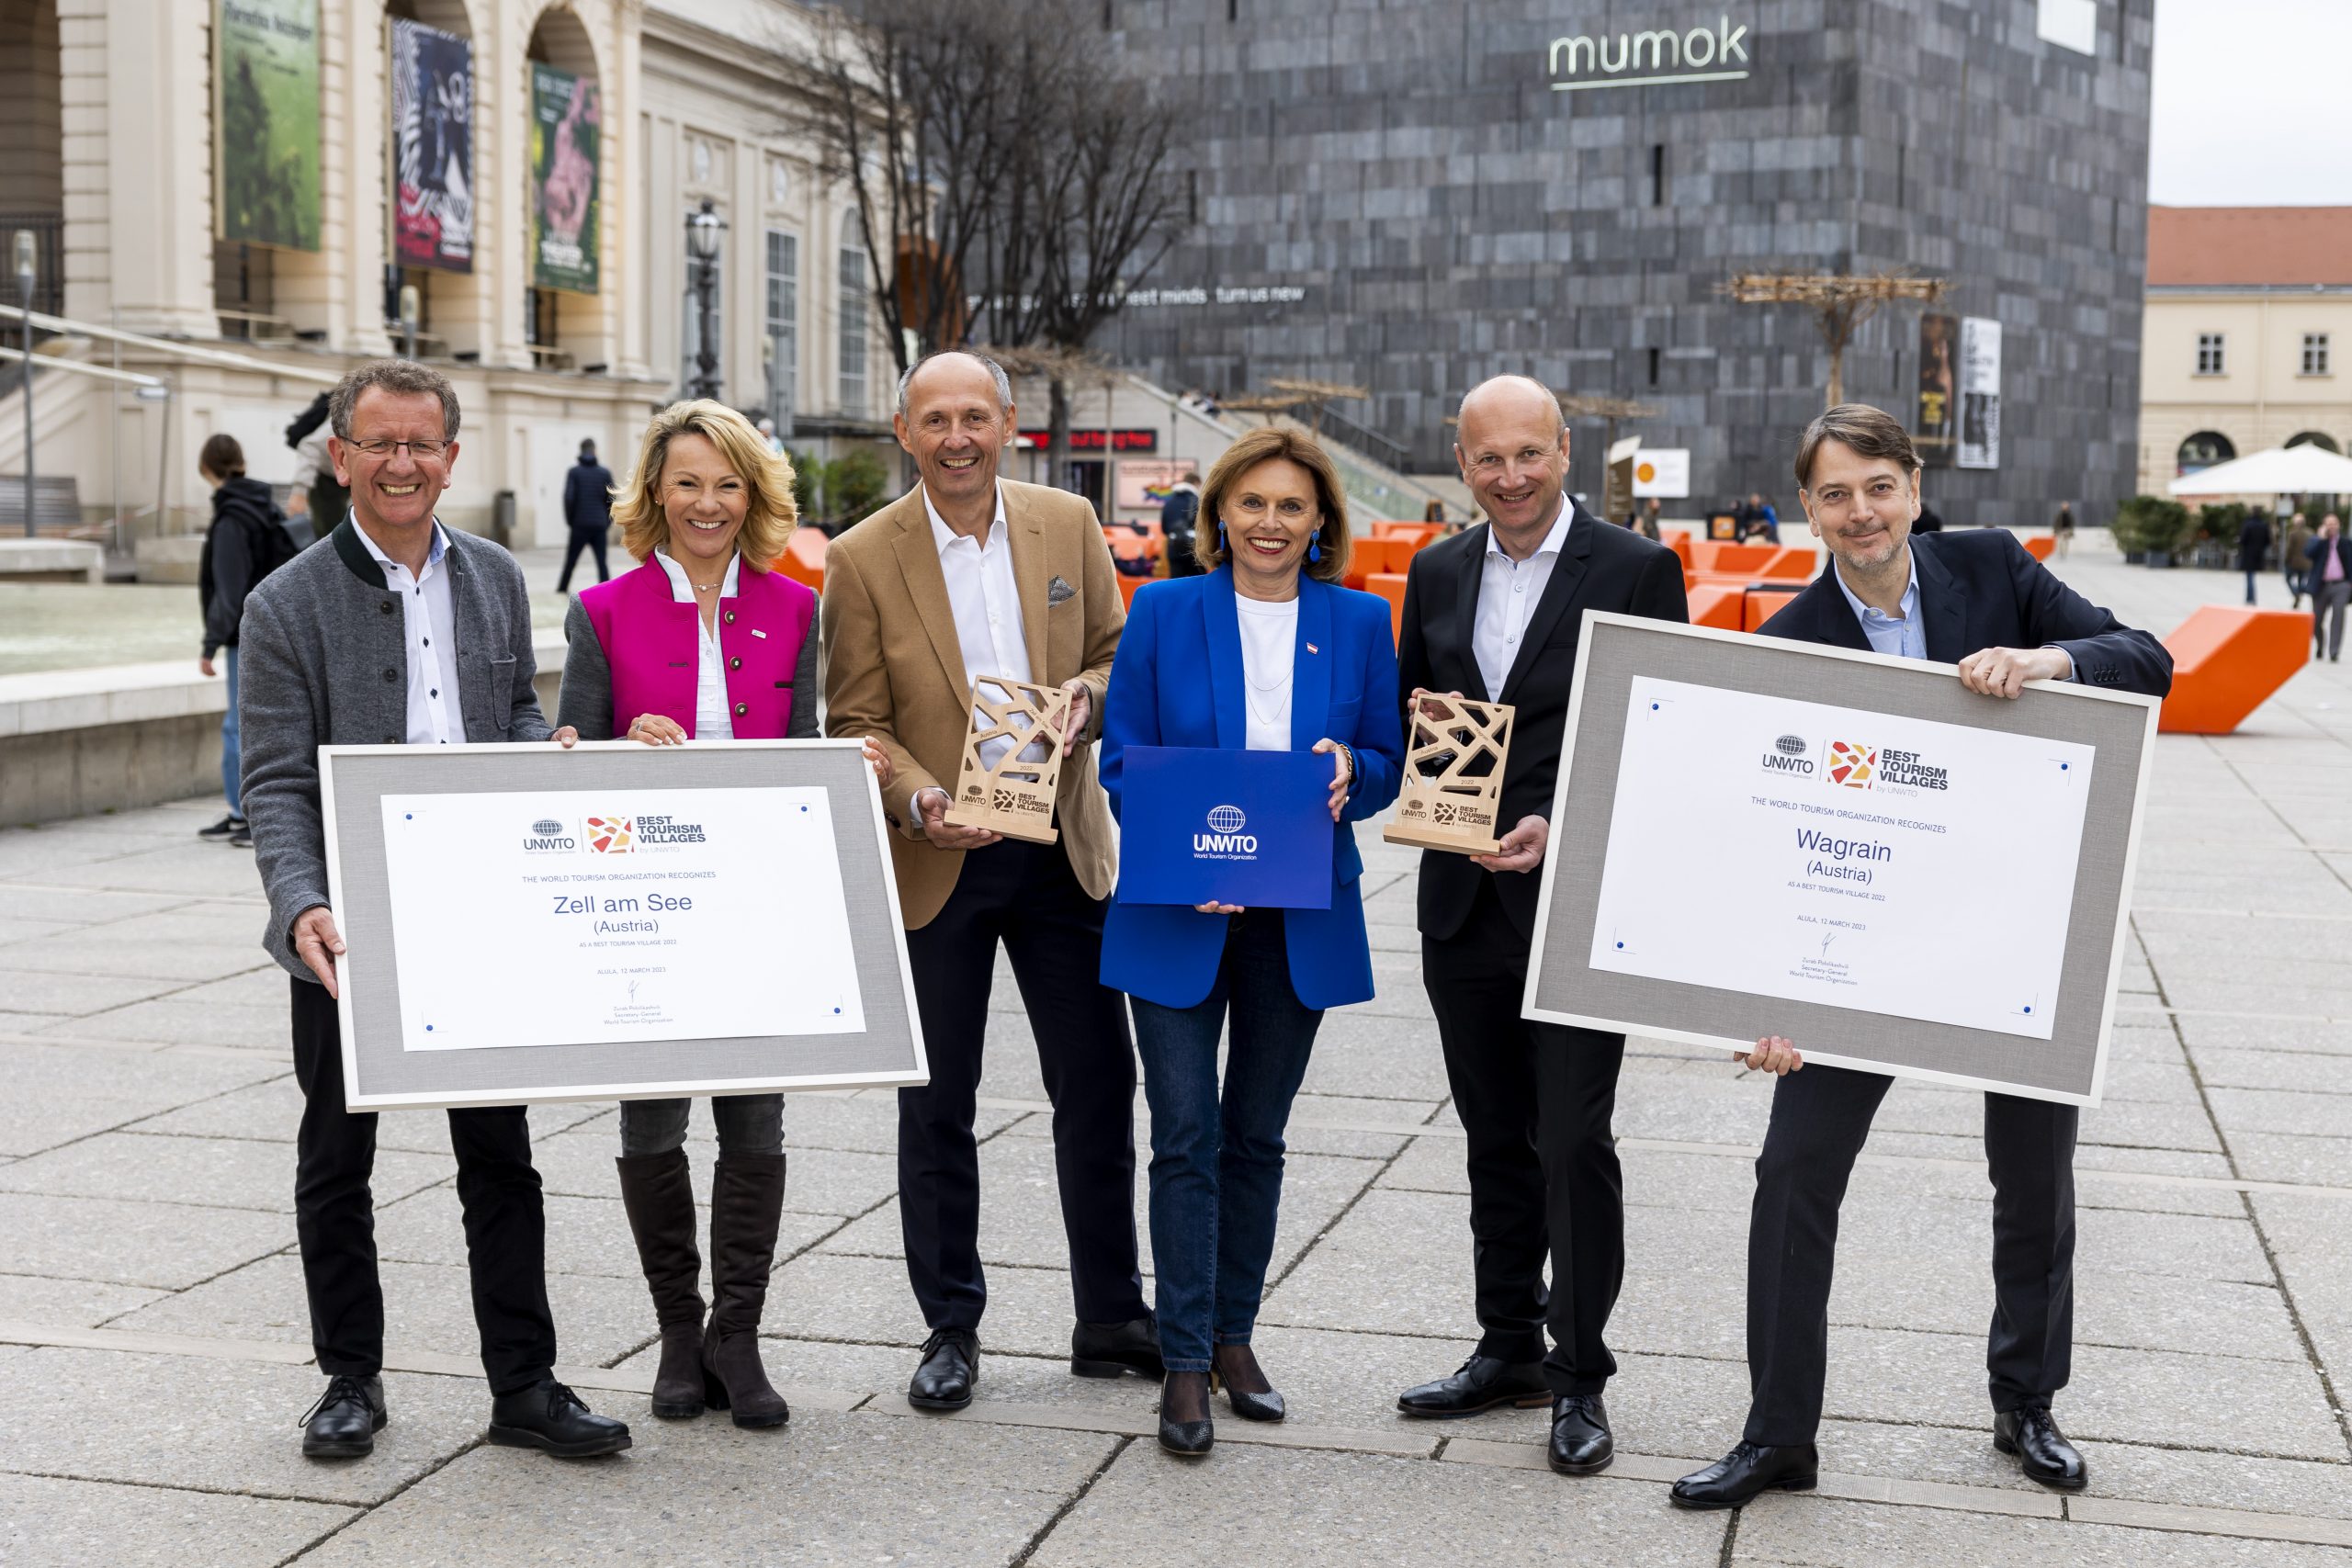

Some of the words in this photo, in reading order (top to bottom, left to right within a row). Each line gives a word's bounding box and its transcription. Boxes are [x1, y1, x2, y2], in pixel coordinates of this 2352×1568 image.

[1549, 14, 1748, 76] mumok
[1159, 286, 1208, 305] minds
[1216, 287, 1249, 304] turn
[1250, 287, 1269, 303] us
[1270, 286, 1306, 302] new
[1762, 753, 1814, 773] UNWTO
[1883, 749, 1920, 763] BEST
[1882, 760, 1948, 780] TOURISM
[1880, 771, 1949, 791] VILLAGES
[1018, 793, 1036, 801] BEST
[1876, 784, 1885, 794] by
[1887, 786, 1918, 798] UNWTO
[961, 795, 987, 805] UNWTO
[1018, 798, 1049, 808] TOURISM
[1017, 804, 1049, 815] VILLAGES
[1401, 808, 1427, 818] UNWTO
[1459, 811, 1491, 820] TOURISM
[1751, 796, 1767, 806] THE
[1769, 799, 1798, 810] WORLD
[1800, 804, 1835, 817] TOURISM
[1837, 809, 1895, 826] ORGANIZATION
[1897, 818, 1947, 834] RECOGNIZES
[637, 816, 673, 825] BEST
[1458, 817, 1491, 826] VILLAGES
[638, 825, 702, 834] TOURISM
[524, 838, 574, 851] UNWTO
[639, 833, 707, 843] VILLAGES
[1193, 834, 1258, 852] UNWTO
[1797, 828, 1892, 863] Wagrain
[608, 873, 666, 881] ORGANIZATION
[668, 871, 716, 879] RECOGNIZES
[1806, 860, 1872, 886] (Austria)
[1802, 882, 1816, 890] BEST
[1818, 885, 1844, 896] TOURISM
[1845, 889, 1870, 899] VILLAGE
[1871, 893, 1886, 902] 2022
[553, 896, 595, 914] Zell
[604, 898, 639, 913] am
[648, 893, 693, 911] See
[594, 919, 659, 935] (Austria)
[1797, 914, 1818, 924] ALULA,
[1829, 919, 1850, 929] MARCH
[1851, 922, 1866, 931] 2023
